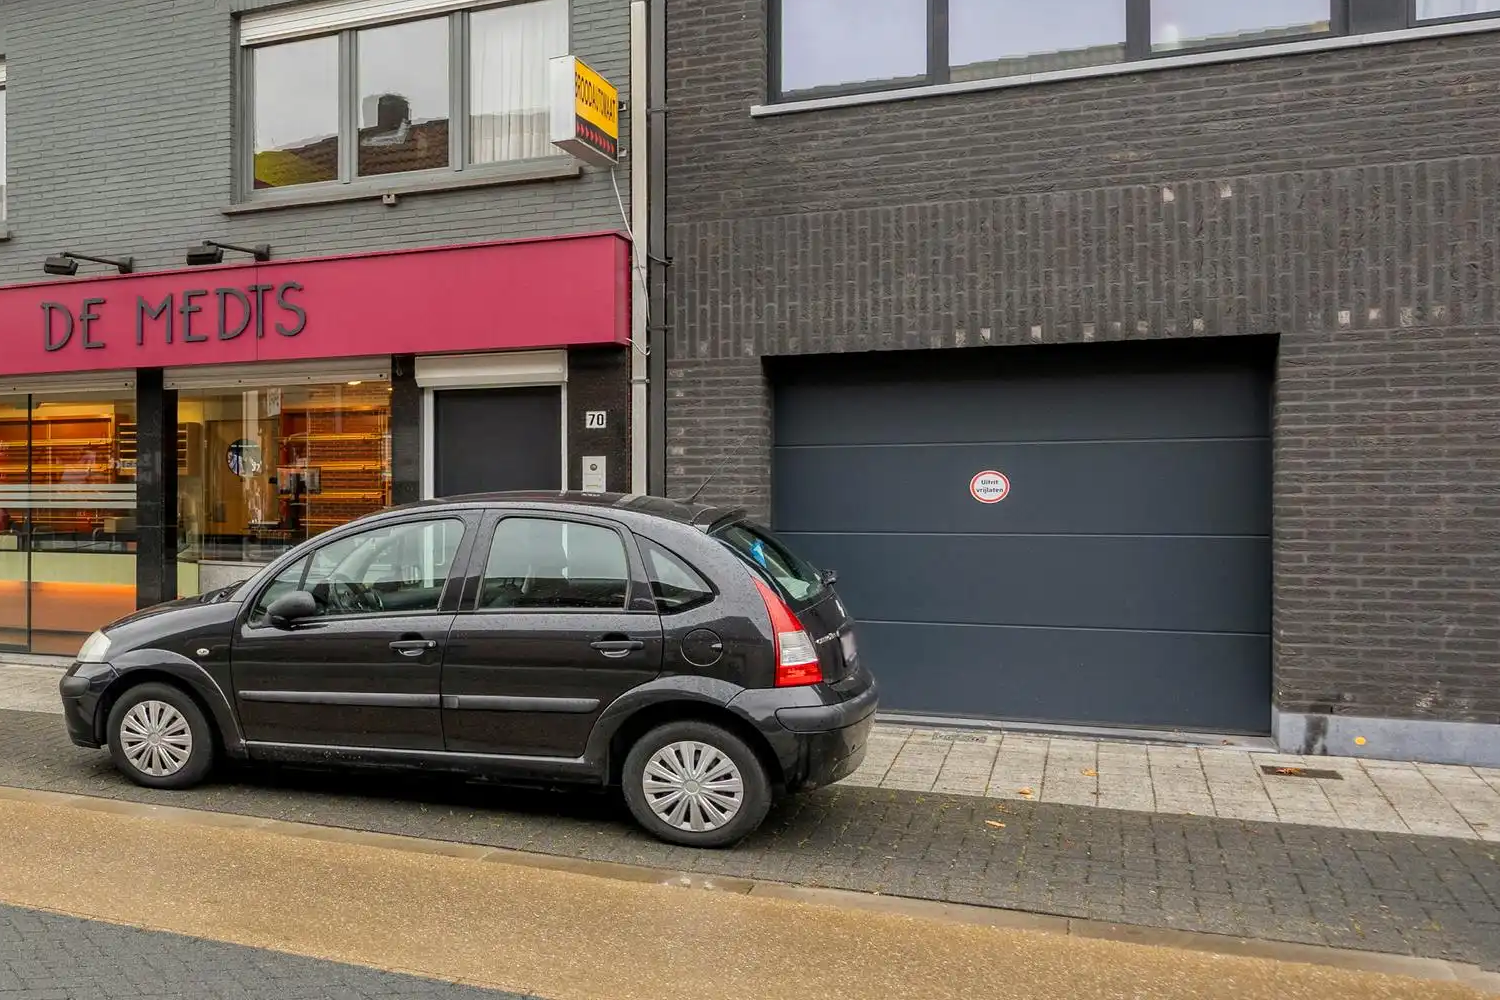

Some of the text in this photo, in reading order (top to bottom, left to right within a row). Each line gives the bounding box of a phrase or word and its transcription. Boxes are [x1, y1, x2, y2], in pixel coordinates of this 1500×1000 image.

[41, 281, 307, 351] DE MEDTS
[588, 413, 604, 426] 70
